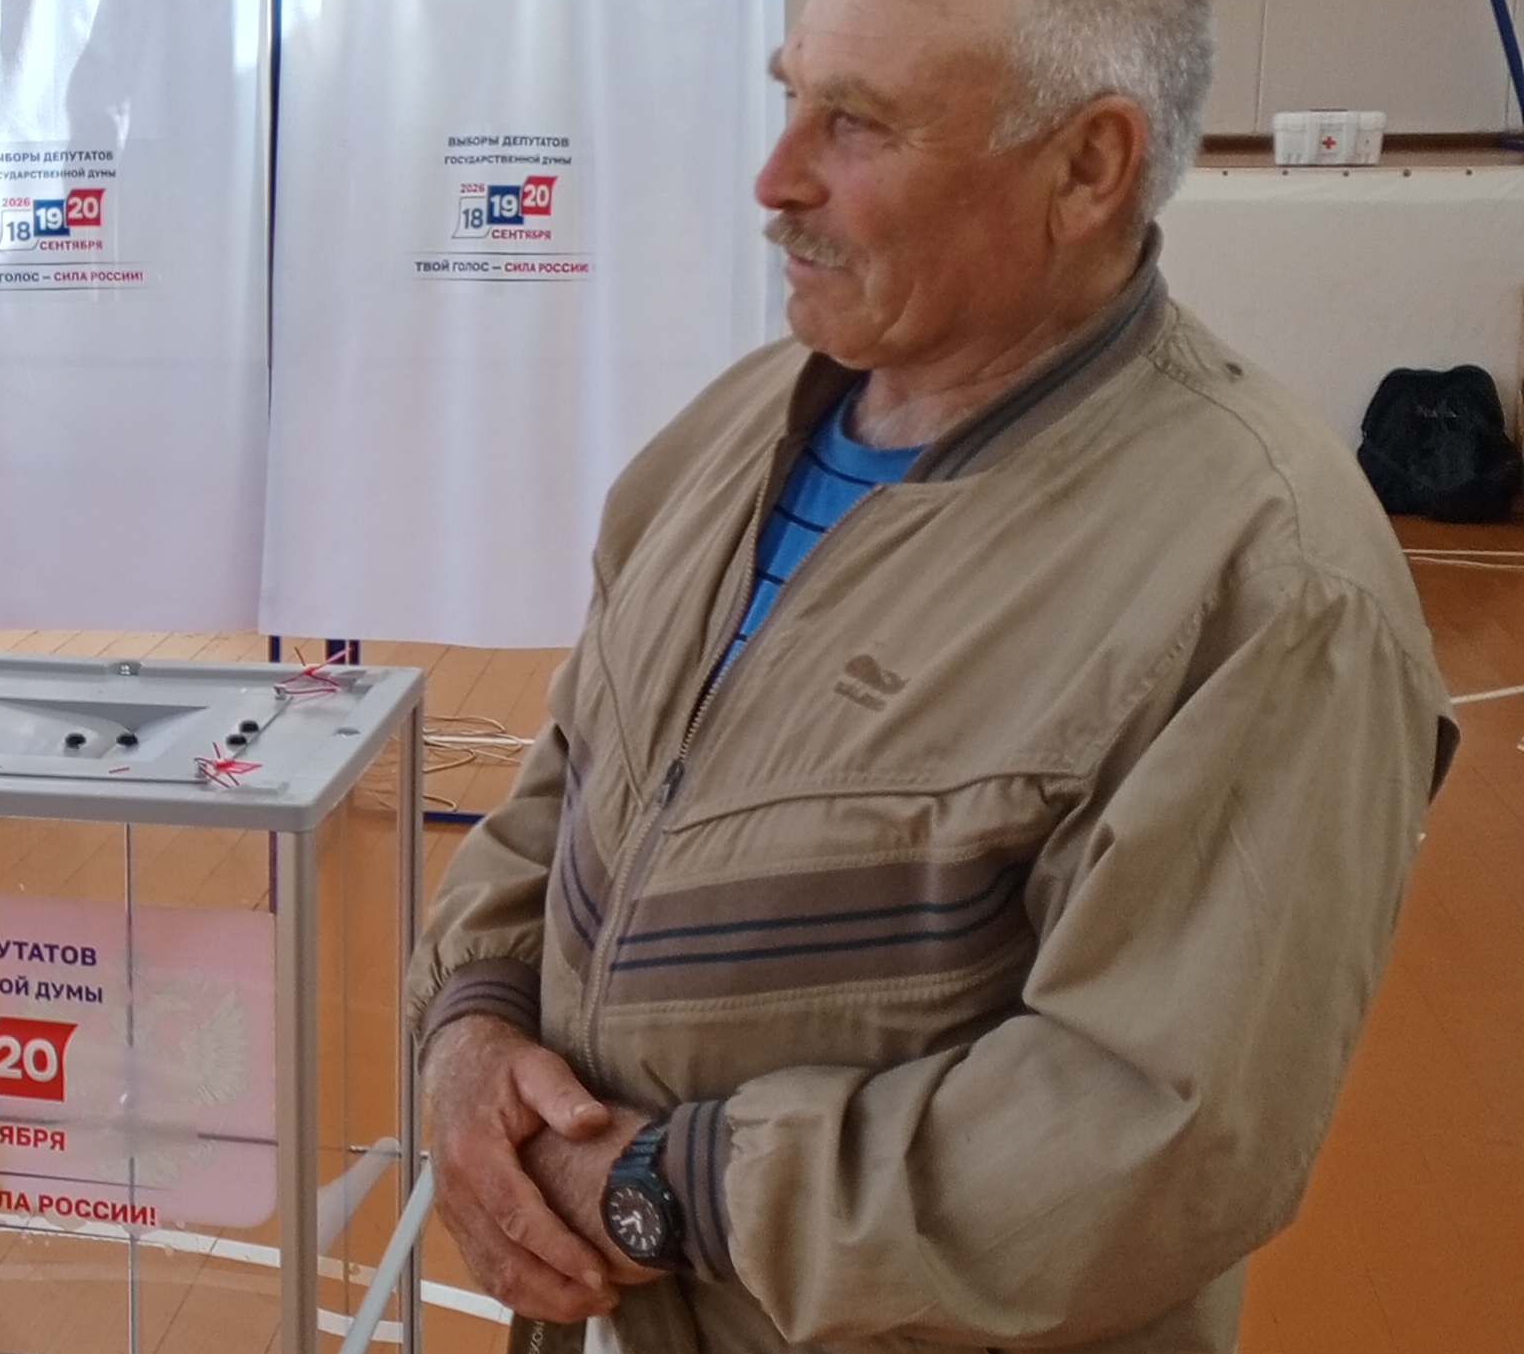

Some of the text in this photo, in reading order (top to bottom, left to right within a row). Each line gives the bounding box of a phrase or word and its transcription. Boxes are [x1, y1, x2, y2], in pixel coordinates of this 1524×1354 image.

[448, 136, 569, 148] ВЫБОРЫ ДЕПУТАТОВ
[43, 150, 113, 163] ДЕПУТАТОВ
[542, 156, 572, 166] ДУМЫ
[87, 169, 116, 180] ДУМЫ
[460, 183, 485, 194] 2026
[2, 198, 30, 207] 2026
[462, 185, 550, 229] 18 19 20
[6, 197, 99, 242] 18 19 20
[491, 229, 552, 240] СЕНТЯБРЯ
[39, 240, 103, 251] СЕНТЯБРЯ
[415, 259, 449, 273] ТВОЙ
[452, 262, 489, 272] ГОЛОС
[504, 262, 536, 273] СИЛА
[54, 271, 88, 282] СИЛА
[90, 270, 143, 282] РОССИИ!
[34, 980, 103, 1004] ДУМЫ
[38, 1195, 157, 1226] РОССИИ!
